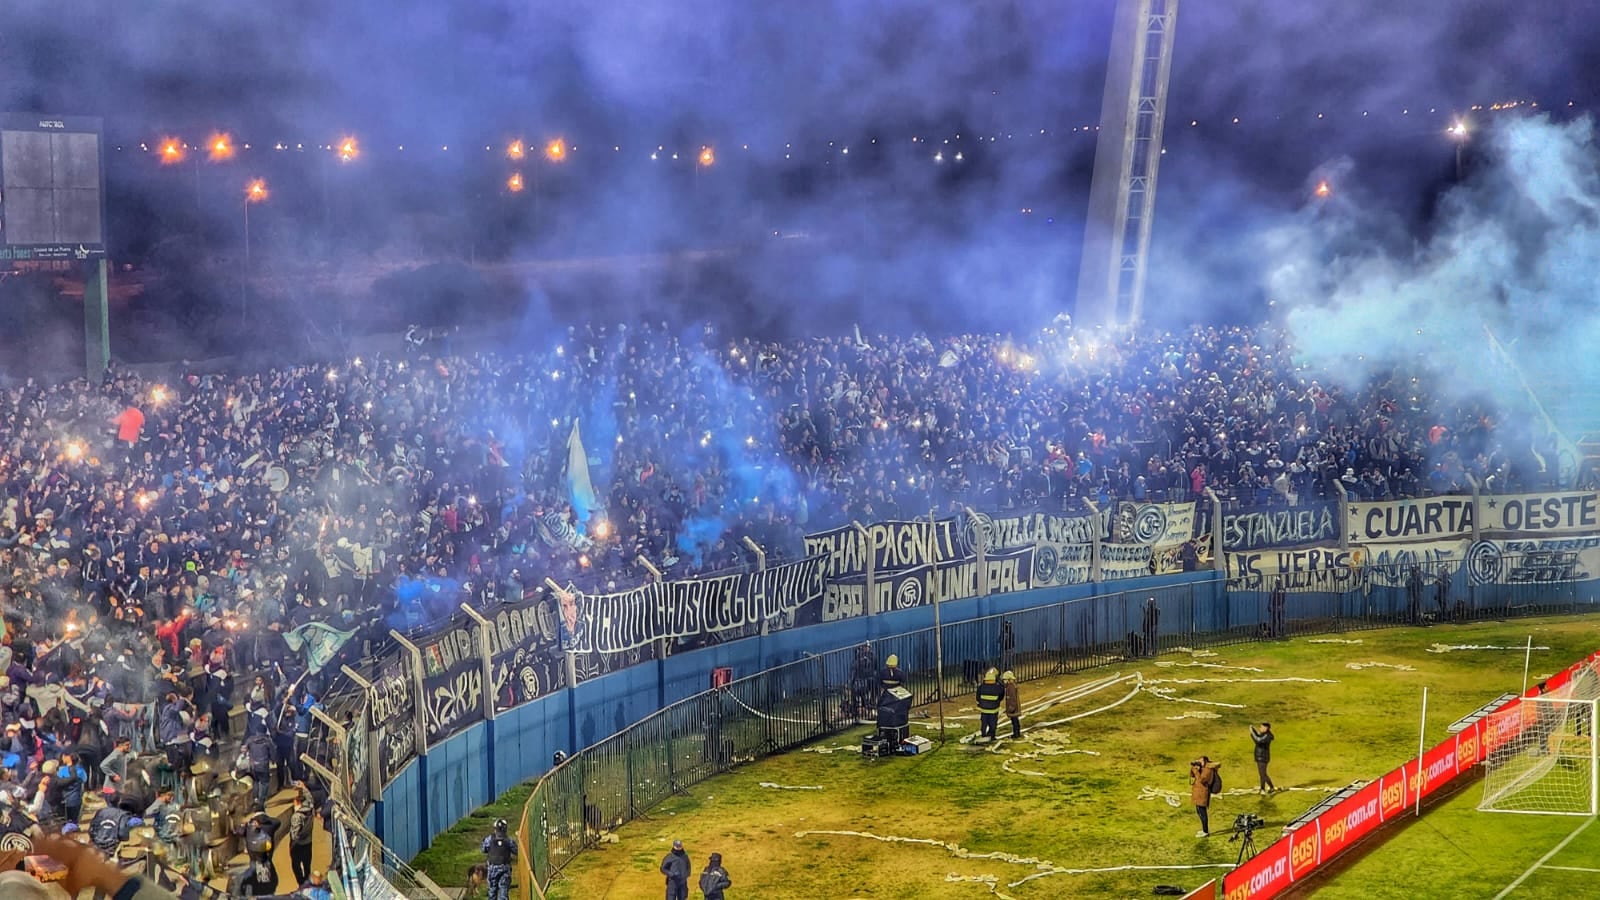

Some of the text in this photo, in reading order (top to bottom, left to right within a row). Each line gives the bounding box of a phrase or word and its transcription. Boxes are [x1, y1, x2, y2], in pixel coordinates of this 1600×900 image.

[994, 513, 1047, 549] VILLA
[1223, 506, 1334, 547] ESTANZUELA
[1365, 495, 1597, 539] CUARTA OESTE
[1083, 544, 1151, 562] FANCISCO
[1225, 552, 1263, 590] LAS
[1278, 549, 1350, 588] HERAS
[822, 558, 1027, 622] BARIO MUNICIPAL
[1458, 735, 1477, 760] easy
[1409, 751, 1455, 792] easy.com.ar
[1382, 779, 1404, 808] easy
[1325, 797, 1378, 845] easy.com.ar
[1292, 832, 1318, 866] easy
